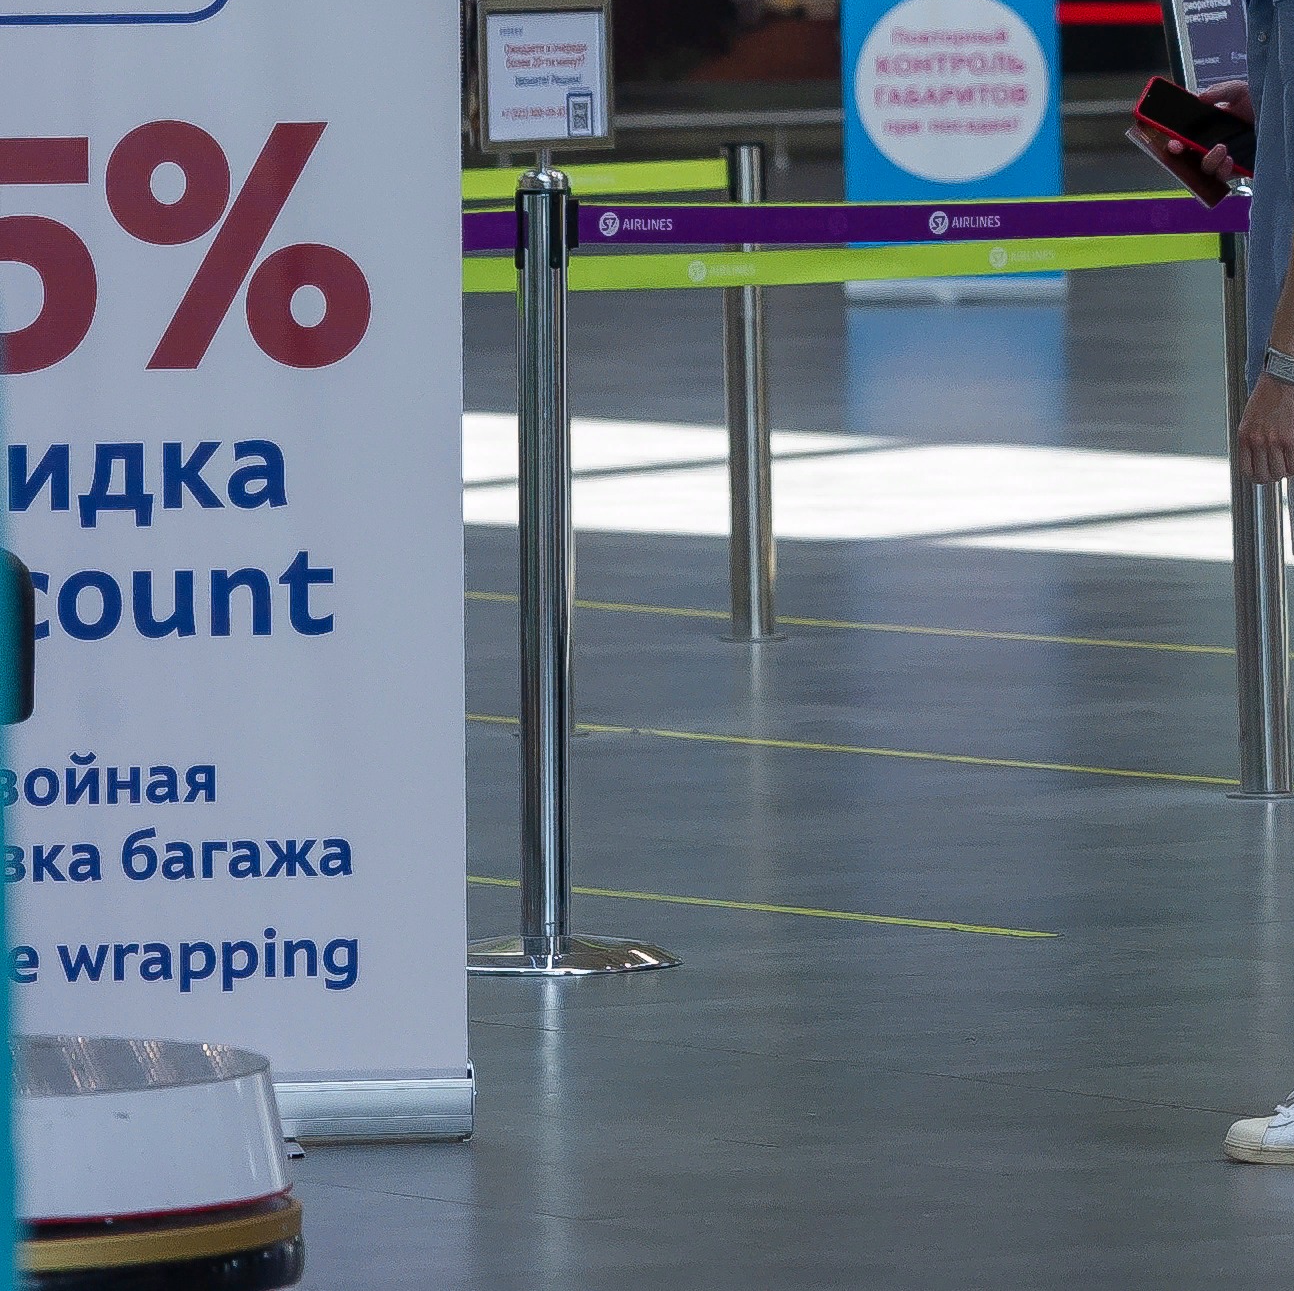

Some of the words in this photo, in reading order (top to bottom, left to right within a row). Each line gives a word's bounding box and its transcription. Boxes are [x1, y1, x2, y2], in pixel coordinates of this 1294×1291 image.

[875, 53, 1026, 77] КОНТРОЛЬ
[873, 83, 1028, 108] ГАБАРИТОВ
[622, 219, 673, 231] AIRLINES
[951, 215, 1001, 228] AIRLINES
[0, 119, 372, 375] 5%
[7, 439, 288, 528] идка
[121, 826, 354, 882] багажа
[57, 928, 360, 993] wrapping
